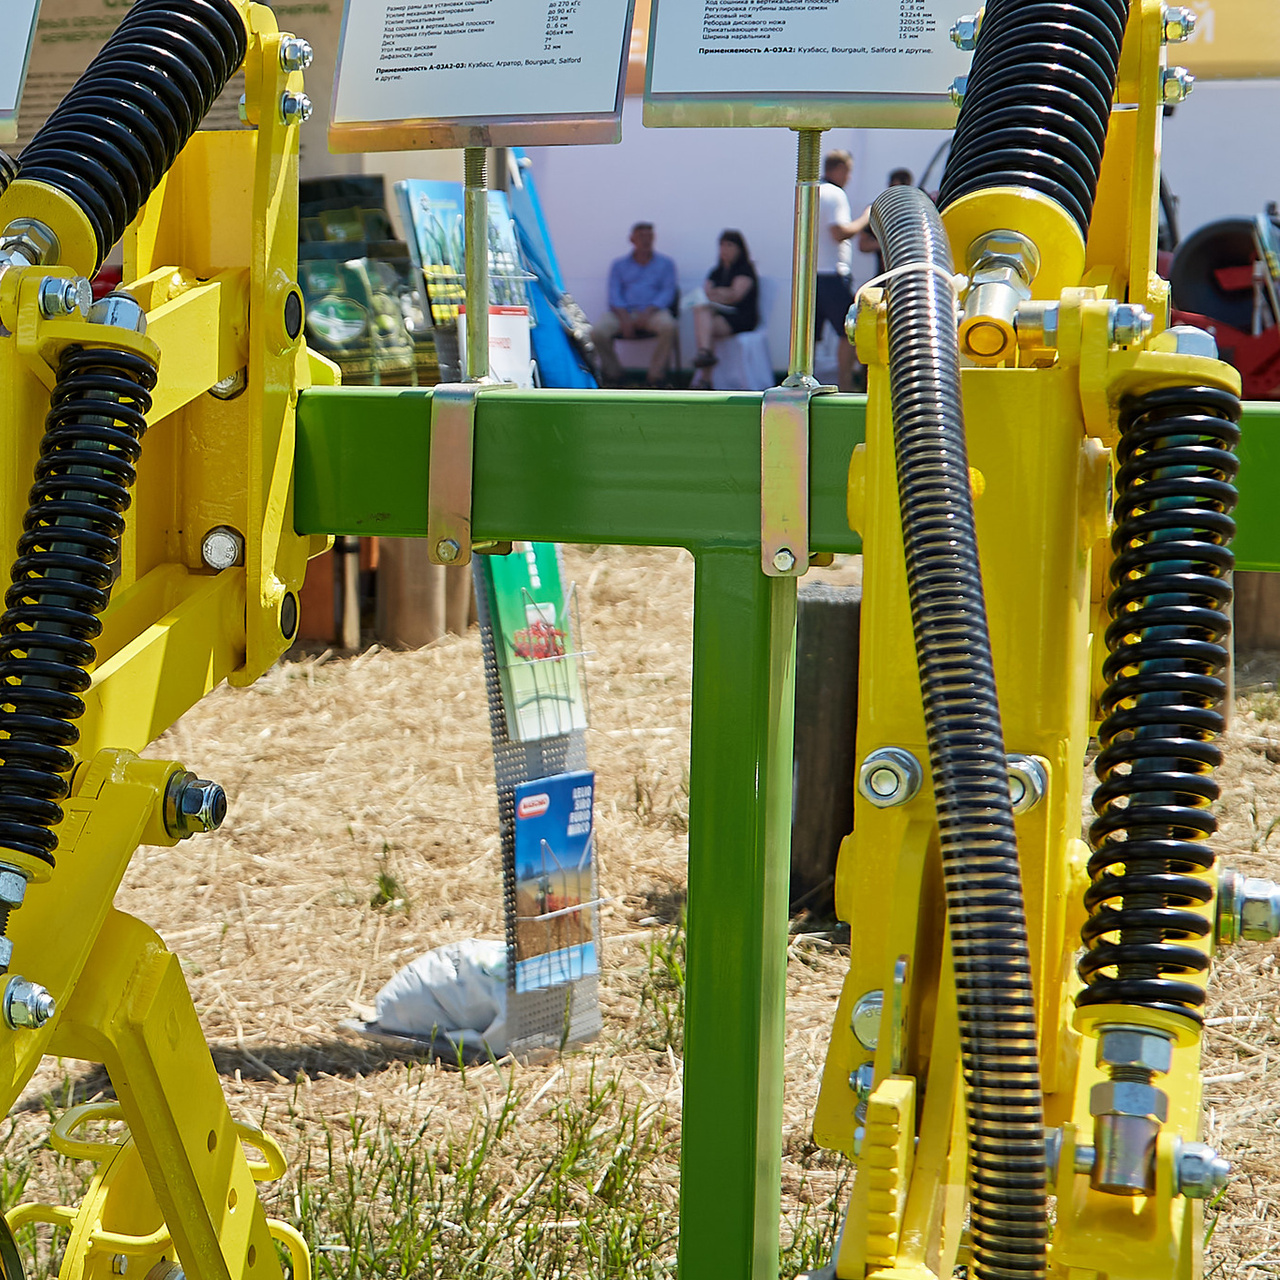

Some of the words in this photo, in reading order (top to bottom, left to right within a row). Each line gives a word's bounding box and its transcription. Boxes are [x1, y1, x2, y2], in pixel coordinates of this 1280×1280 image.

[704, 5, 747, 13] Регулировка
[747, 5, 777, 13] глубины
[703, 12, 738, 20] Дисковый
[703, 19, 732, 27] Реборда
[702, 26, 759, 34] Прикатывающее
[698, 47, 762, 56] Применяемость
[797, 46, 829, 54] Кузбасс,
[831, 46, 869, 54] Bourgault,
[870, 46, 897, 54] Salford
